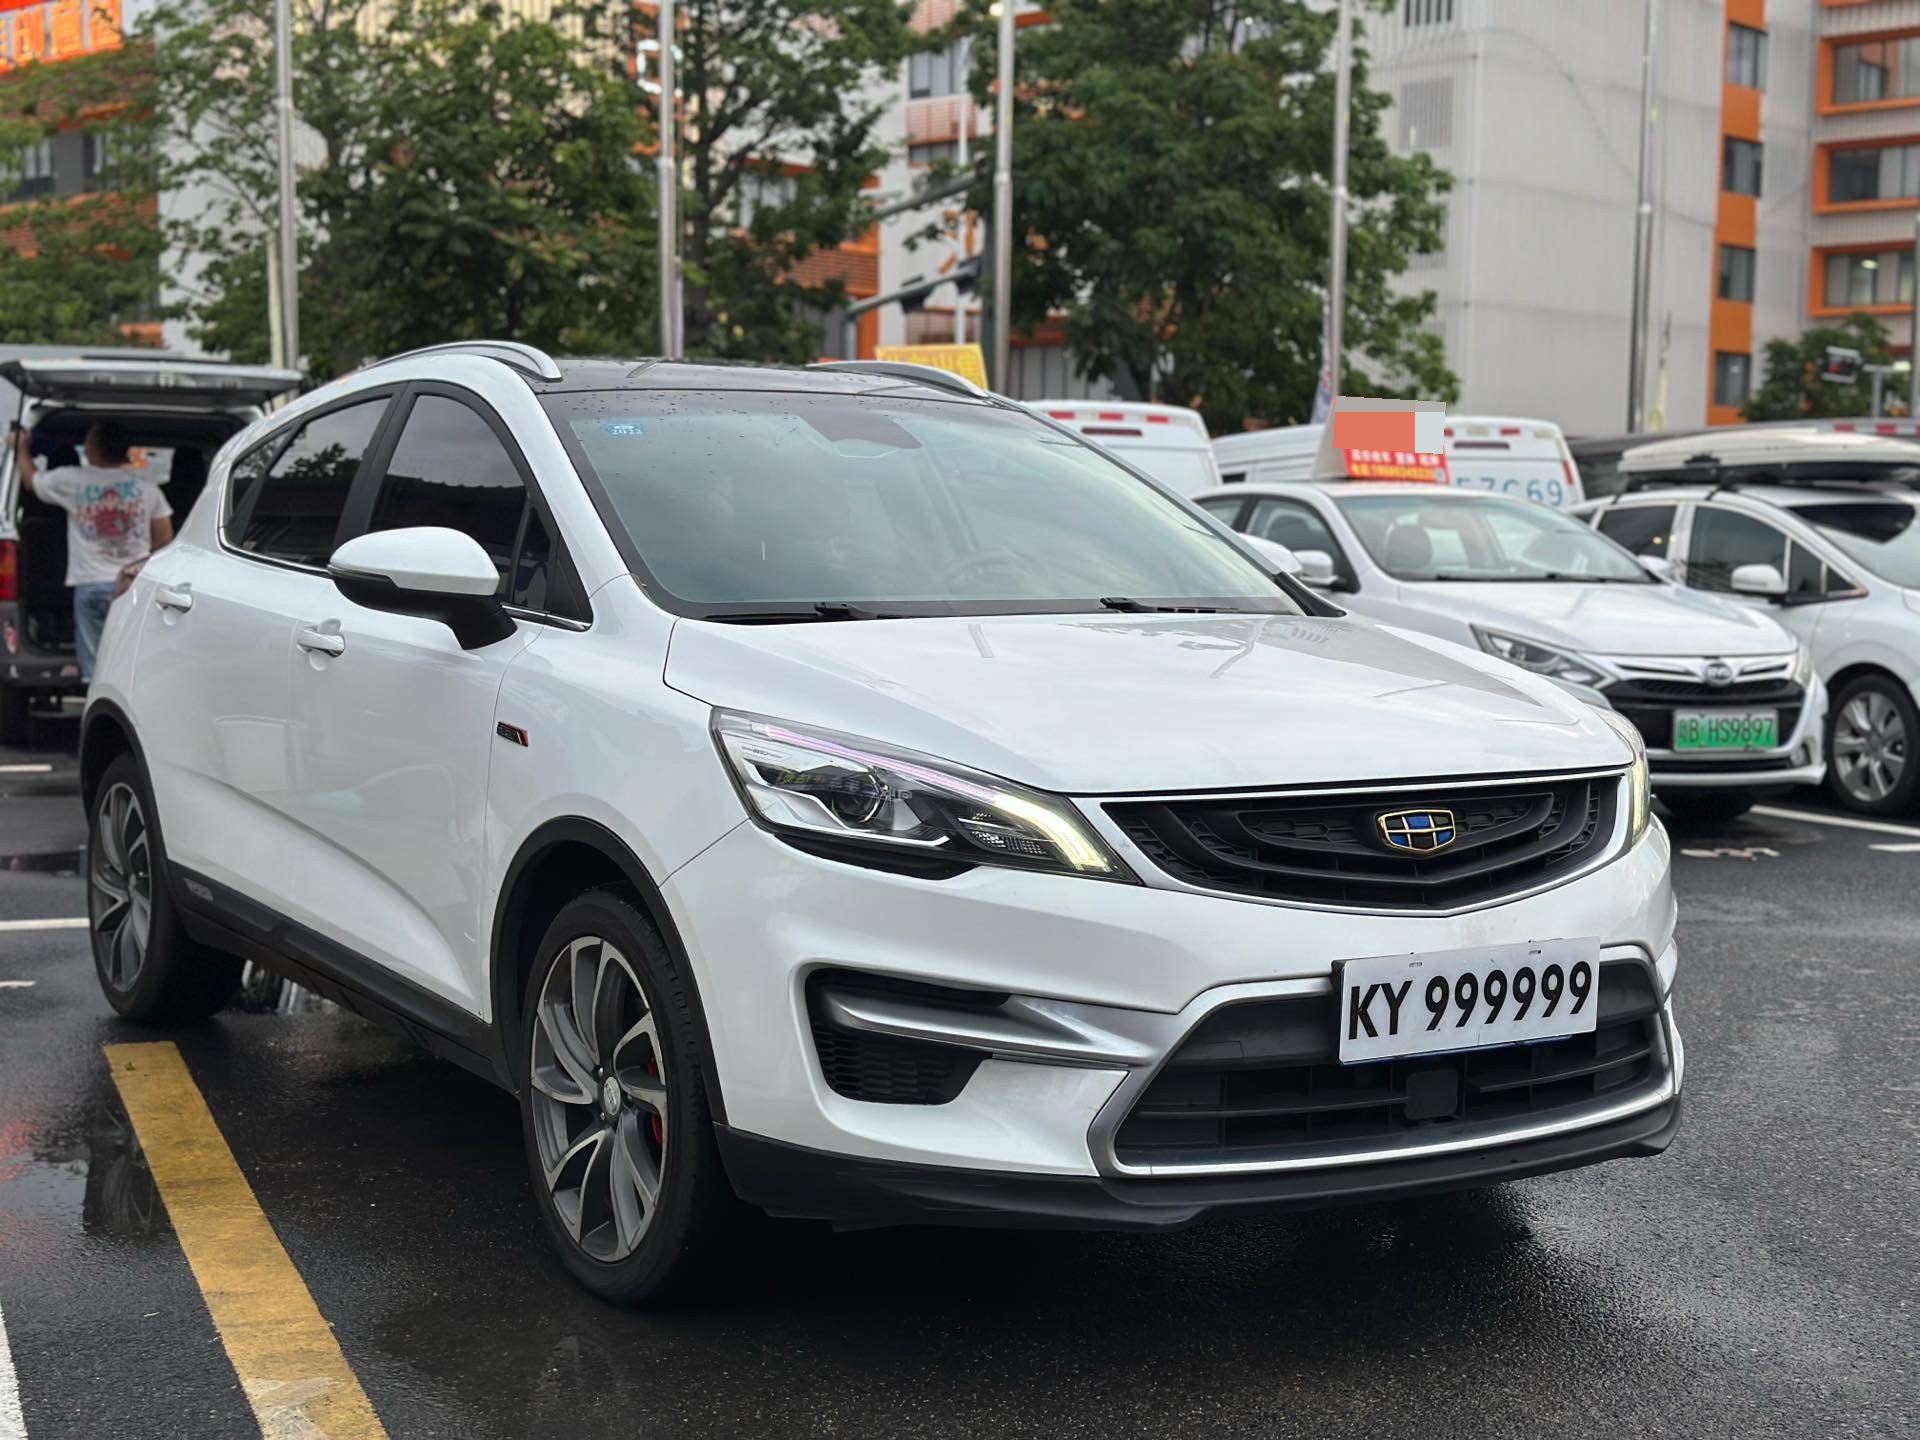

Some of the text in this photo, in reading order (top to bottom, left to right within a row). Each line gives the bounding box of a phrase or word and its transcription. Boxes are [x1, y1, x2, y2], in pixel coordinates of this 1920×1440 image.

[1707, 717, 1774, 743] HS9897
[1348, 960, 1593, 1041] KY 999999
